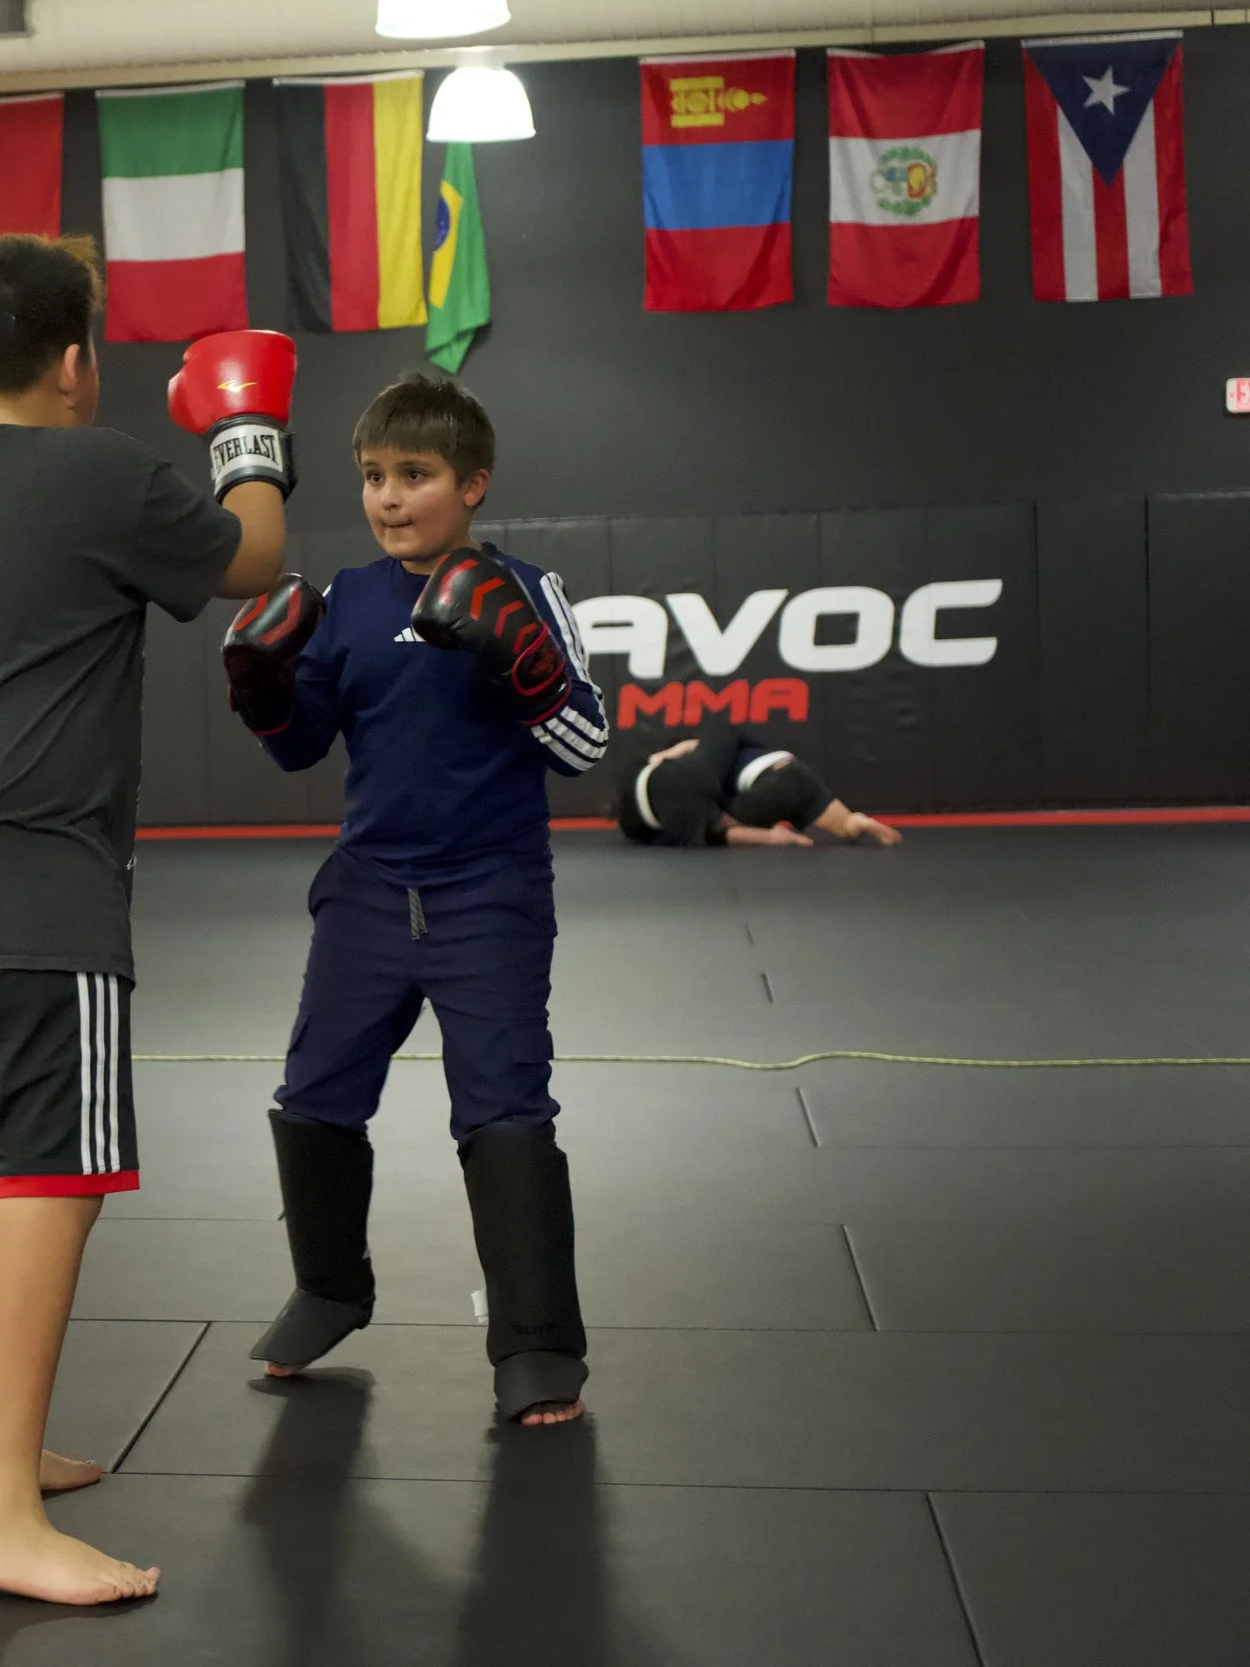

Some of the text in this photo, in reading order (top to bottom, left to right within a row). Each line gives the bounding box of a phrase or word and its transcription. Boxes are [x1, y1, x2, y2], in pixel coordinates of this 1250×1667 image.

[213, 434, 279, 470] EVERLAST
[572, 579, 1003, 679] AVOC
[617, 678, 810, 729] MMA
